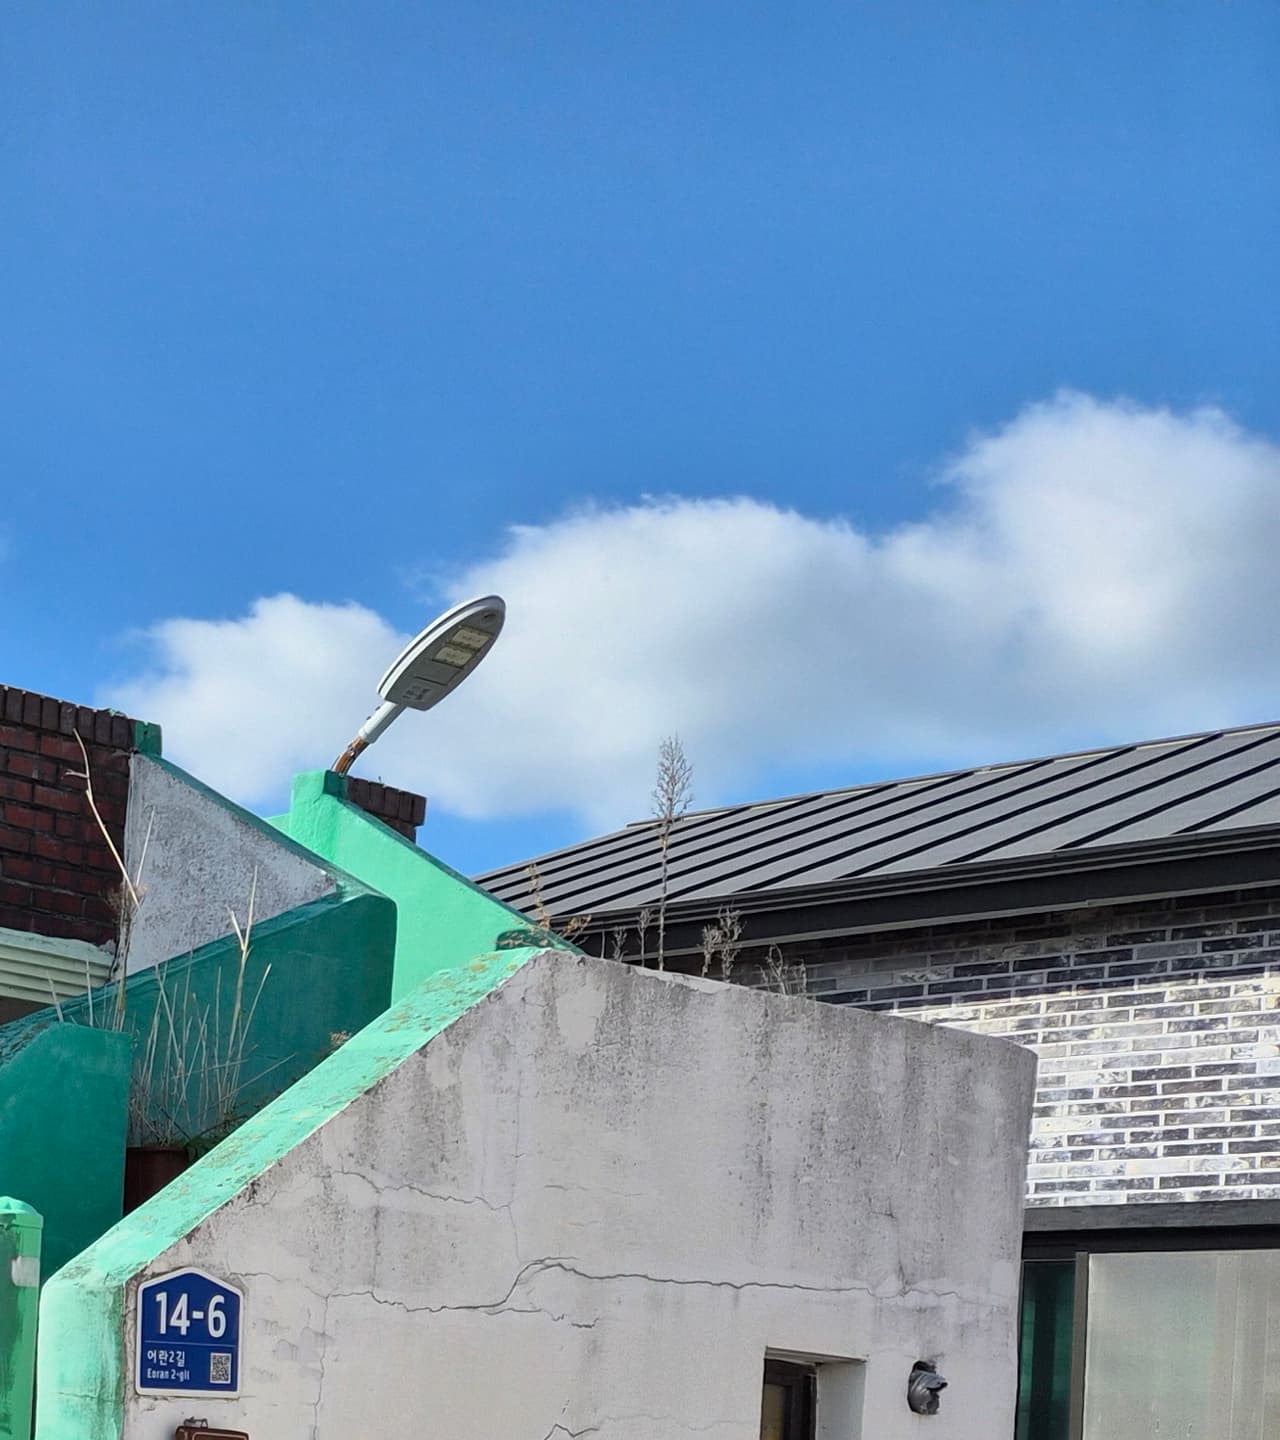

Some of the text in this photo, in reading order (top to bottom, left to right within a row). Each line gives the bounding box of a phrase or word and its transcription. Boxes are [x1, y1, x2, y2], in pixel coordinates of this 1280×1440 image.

[155, 1291, 227, 1338] 14-6
[147, 1349, 185, 1368] 어란2길
[147, 1368, 190, 1383] Eoran 2-gil
